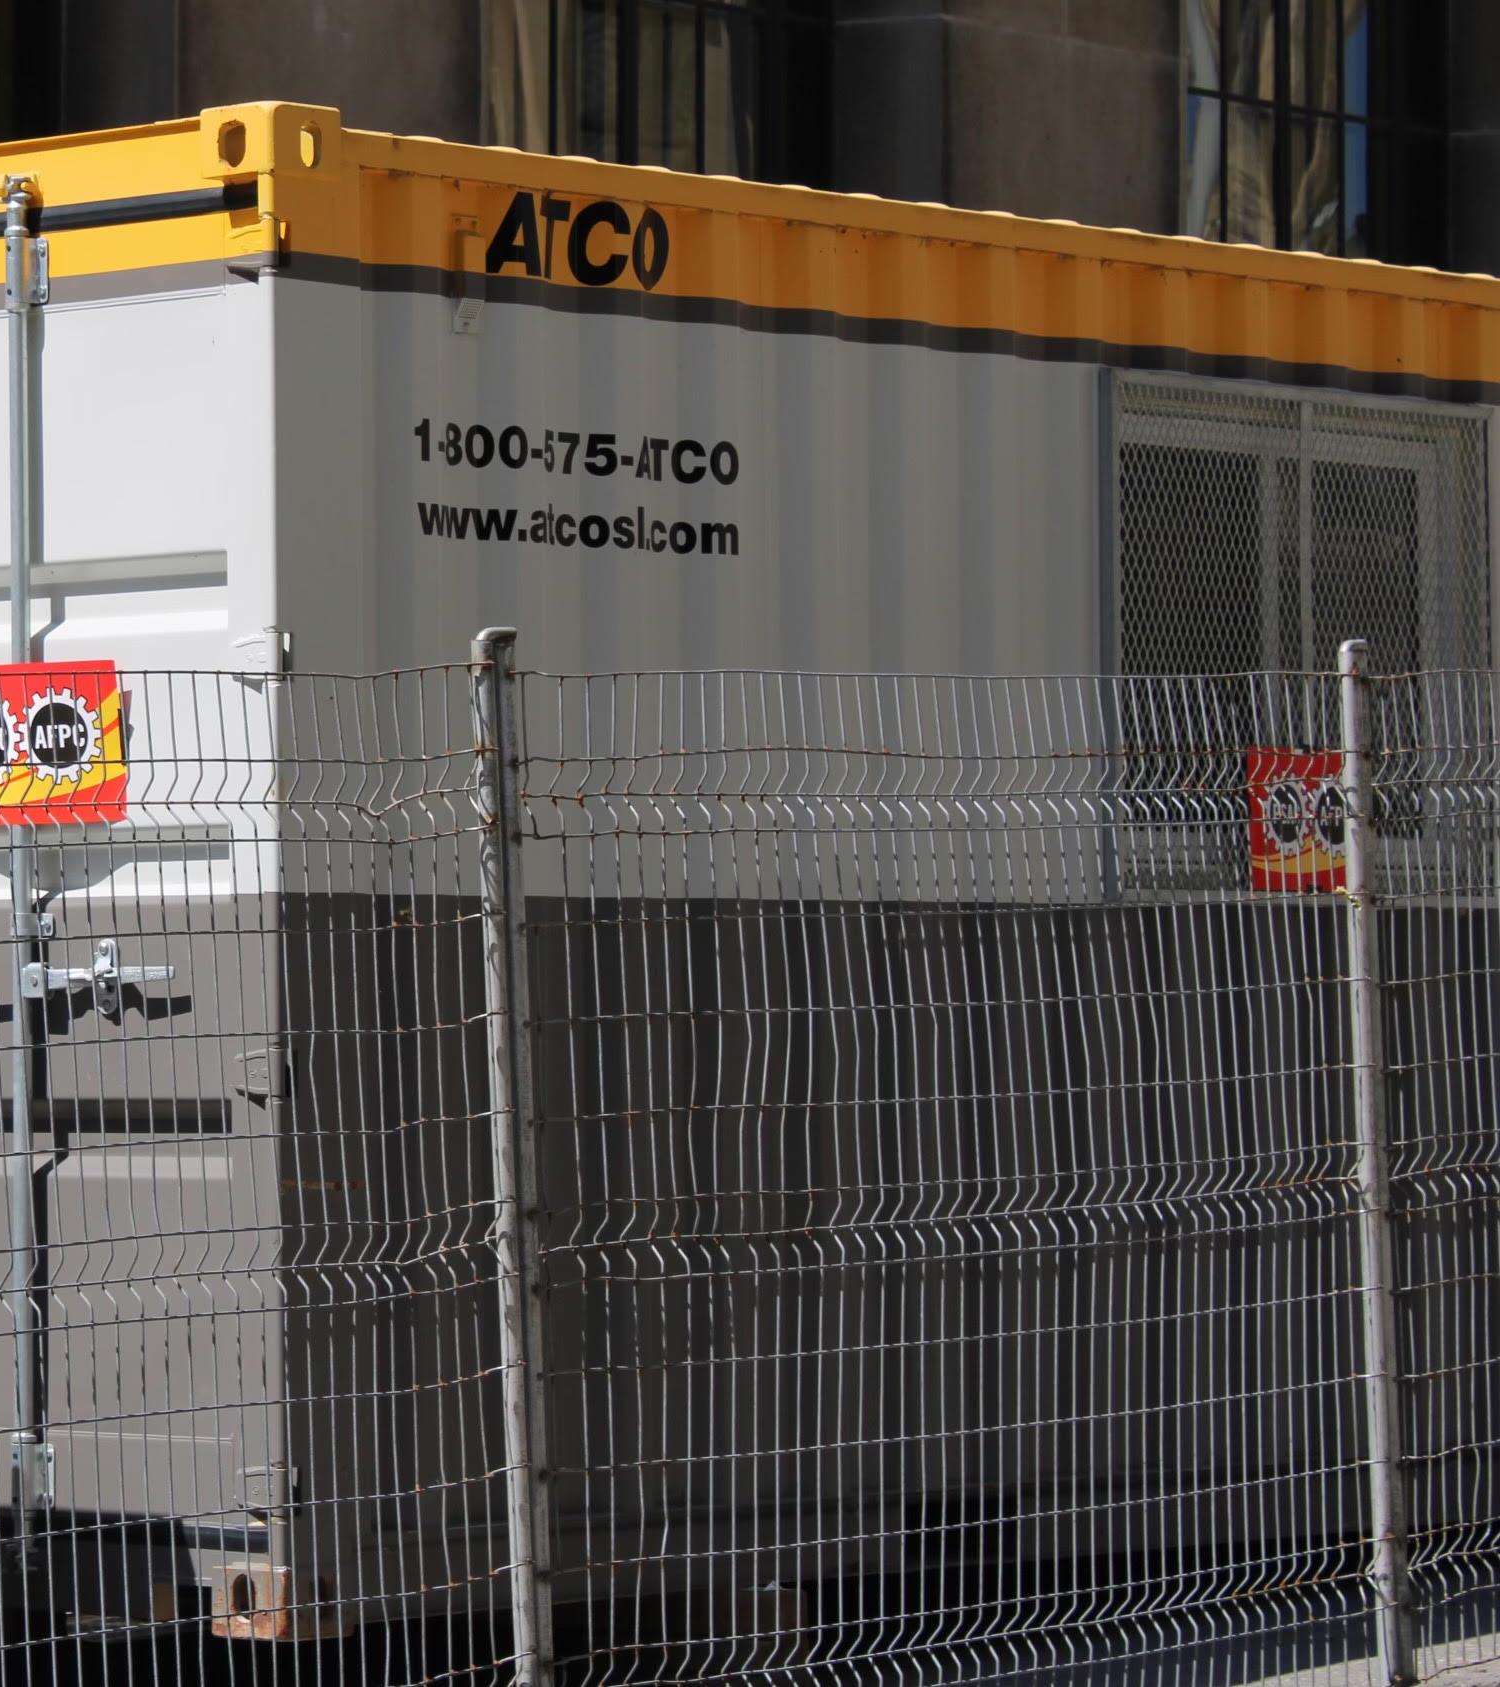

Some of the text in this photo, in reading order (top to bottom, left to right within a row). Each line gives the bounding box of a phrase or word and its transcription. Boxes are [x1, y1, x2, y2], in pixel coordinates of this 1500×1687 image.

[485, 191, 669, 290] ATCO
[414, 418, 739, 486] 1-800-575-ATCO
[418, 502, 739, 555] www.atcosl.com
[35, 723, 86, 750] AFPC
